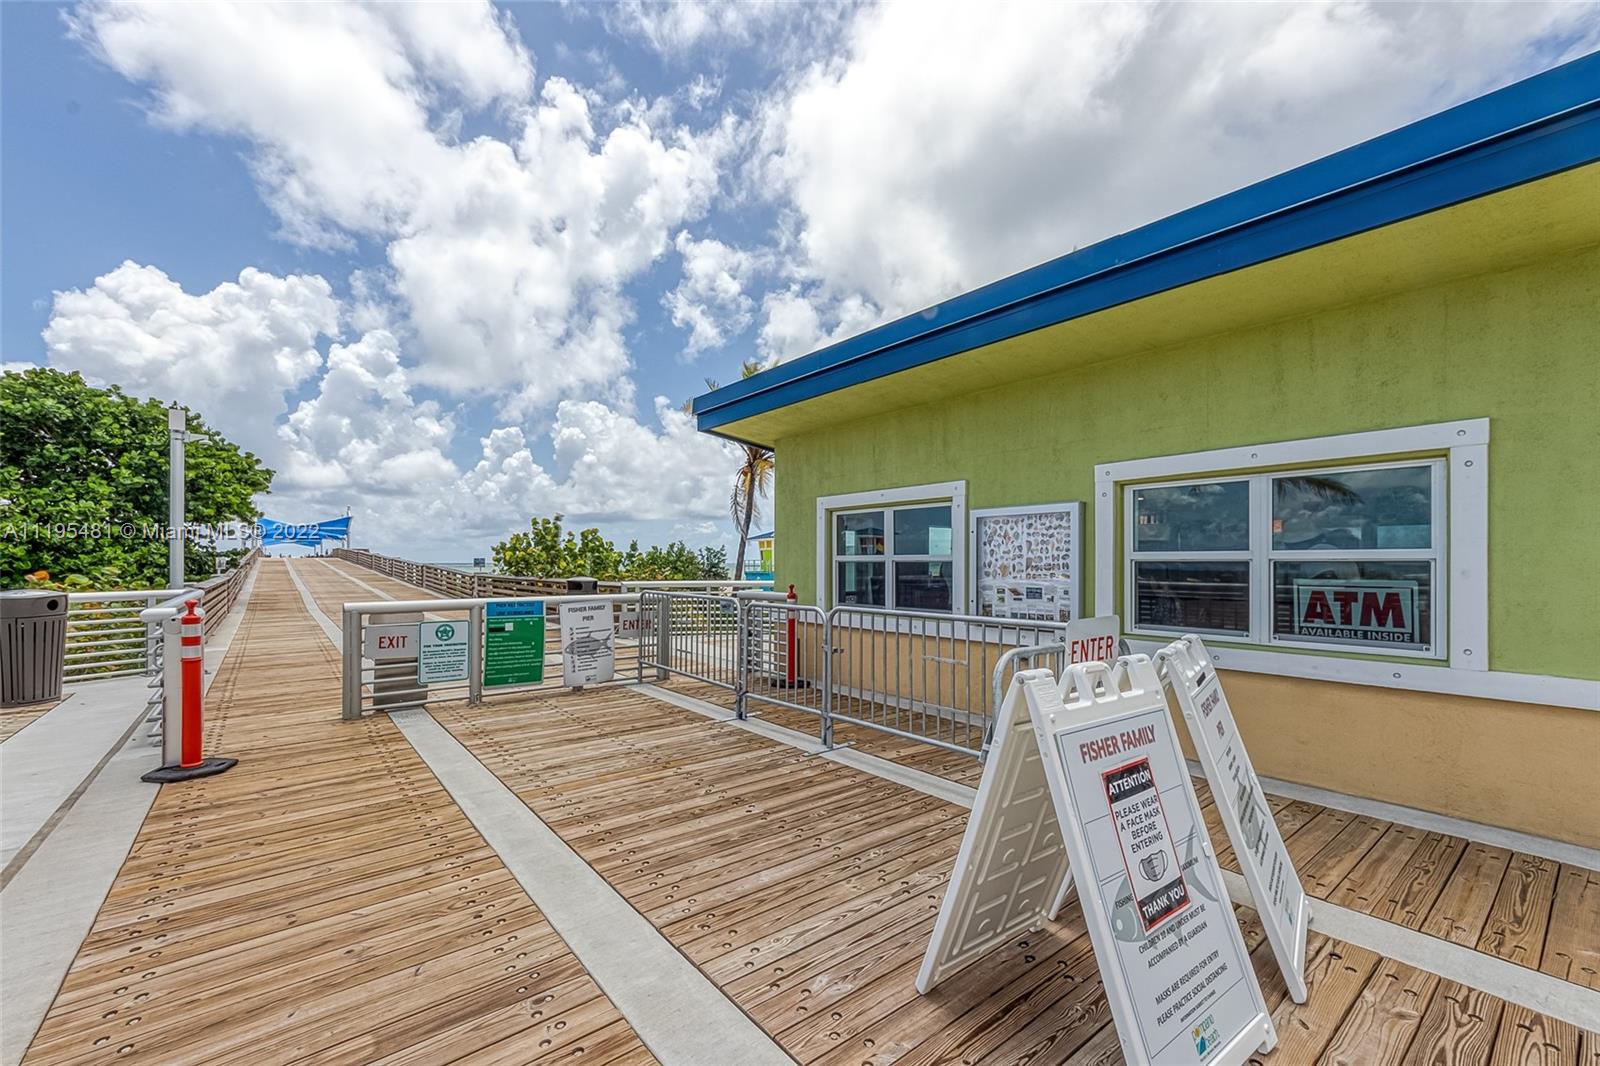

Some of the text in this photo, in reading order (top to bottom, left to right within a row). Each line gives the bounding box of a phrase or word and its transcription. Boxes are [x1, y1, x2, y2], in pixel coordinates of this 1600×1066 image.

[1302, 590, 1406, 628] ATM
[378, 635, 407, 649] EXIT
[1302, 627, 1411, 642] AVAILABLE INSIDE
[1071, 636, 1113, 664] ENTER
[1080, 724, 1156, 764] FISHER FAMILY
[1108, 768, 1152, 796] ATTENTION
[1115, 794, 1159, 820] PLEASE WEAR
[1120, 806, 1162, 832] A FACE MASK
[1130, 832, 1164, 854] ENTERING
[1131, 821, 1157, 841] BEFORE
[1142, 884, 1185, 919] THANK YOU
[1138, 936, 1161, 954] CHILDREN
[1147, 940, 1179, 968] ACCOMPANIED
[1155, 950, 1219, 1005] MASKS ARE REQUIRED FOR ENTRY
[1157, 962, 1228, 1026] PLEASE PRACTICE SOCIAL DISTANCING
